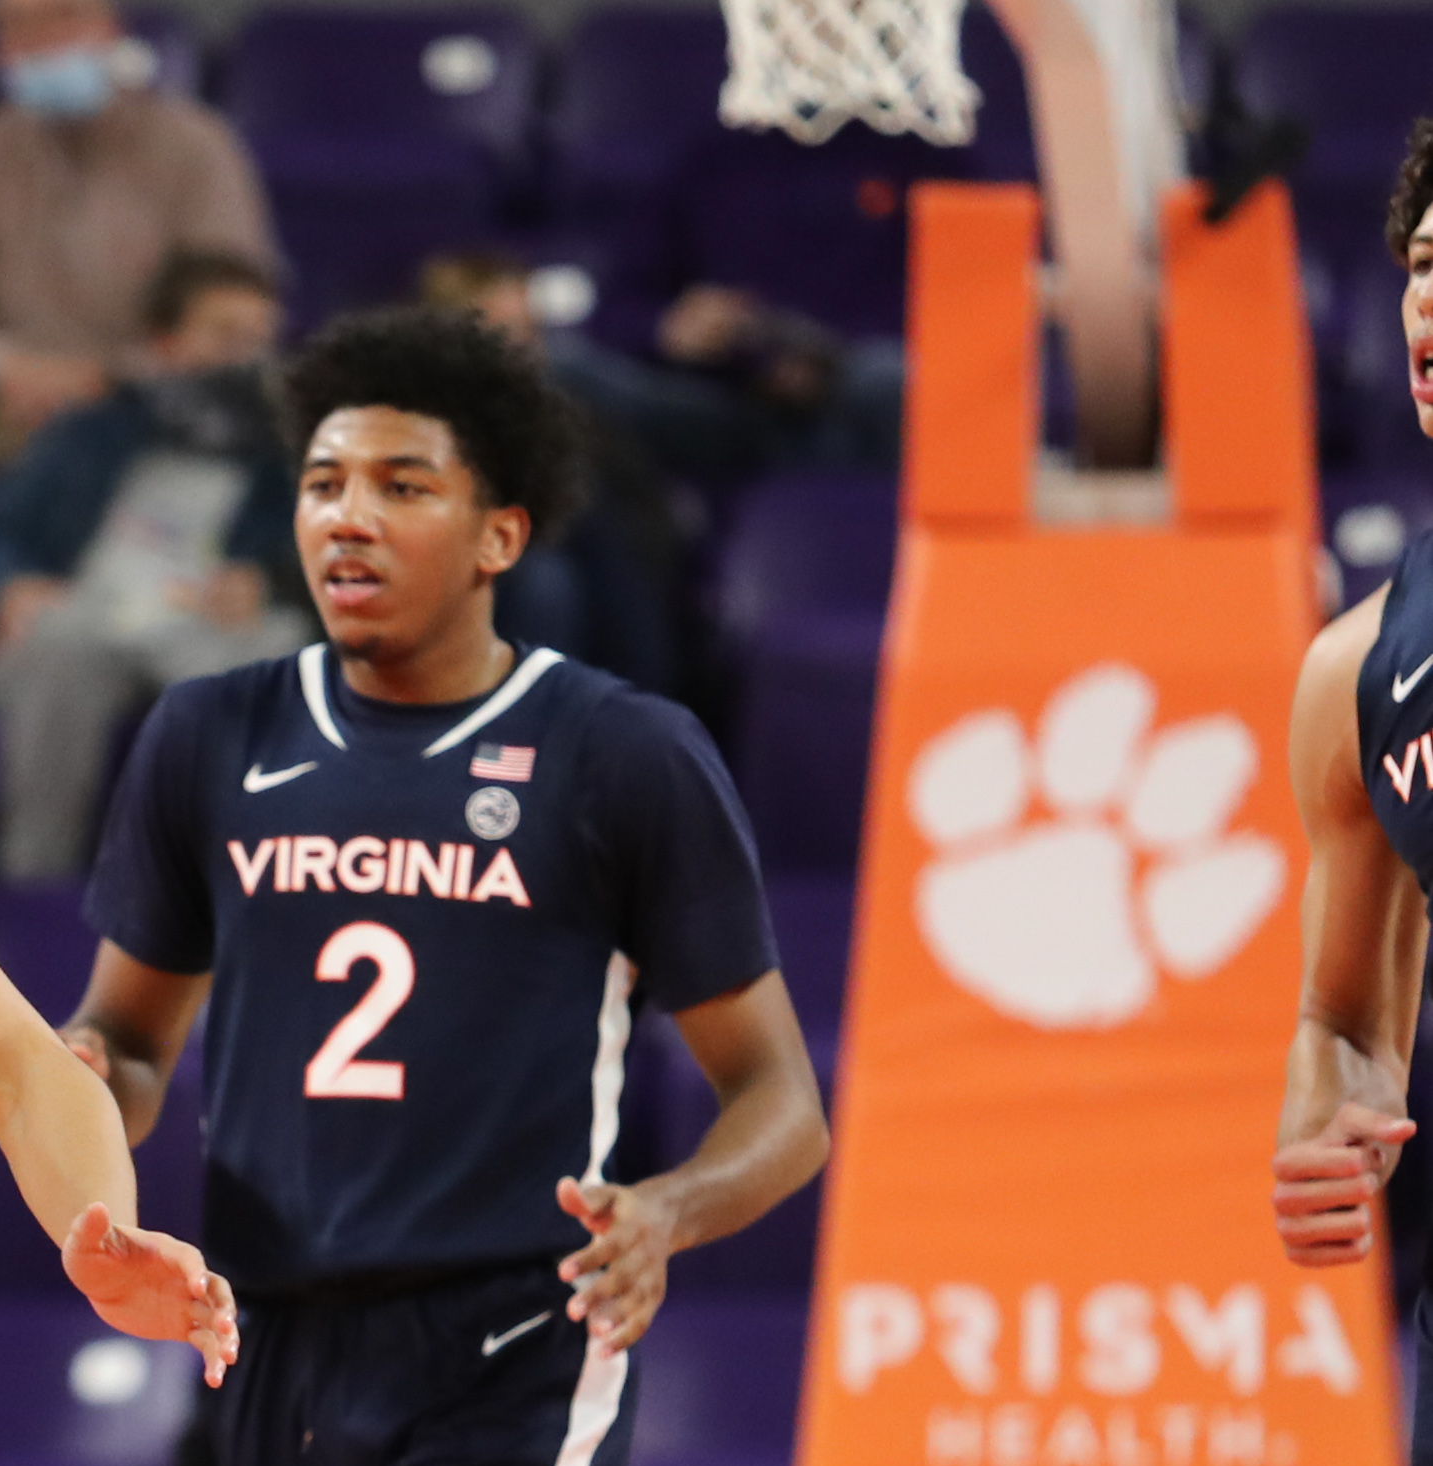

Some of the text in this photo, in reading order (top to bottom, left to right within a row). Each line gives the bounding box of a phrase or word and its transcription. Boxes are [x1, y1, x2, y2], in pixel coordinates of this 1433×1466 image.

[227, 834, 532, 908] VIRGINIA
[303, 920, 416, 1100] 2
[837, 1281, 1362, 1396] PRISMA
